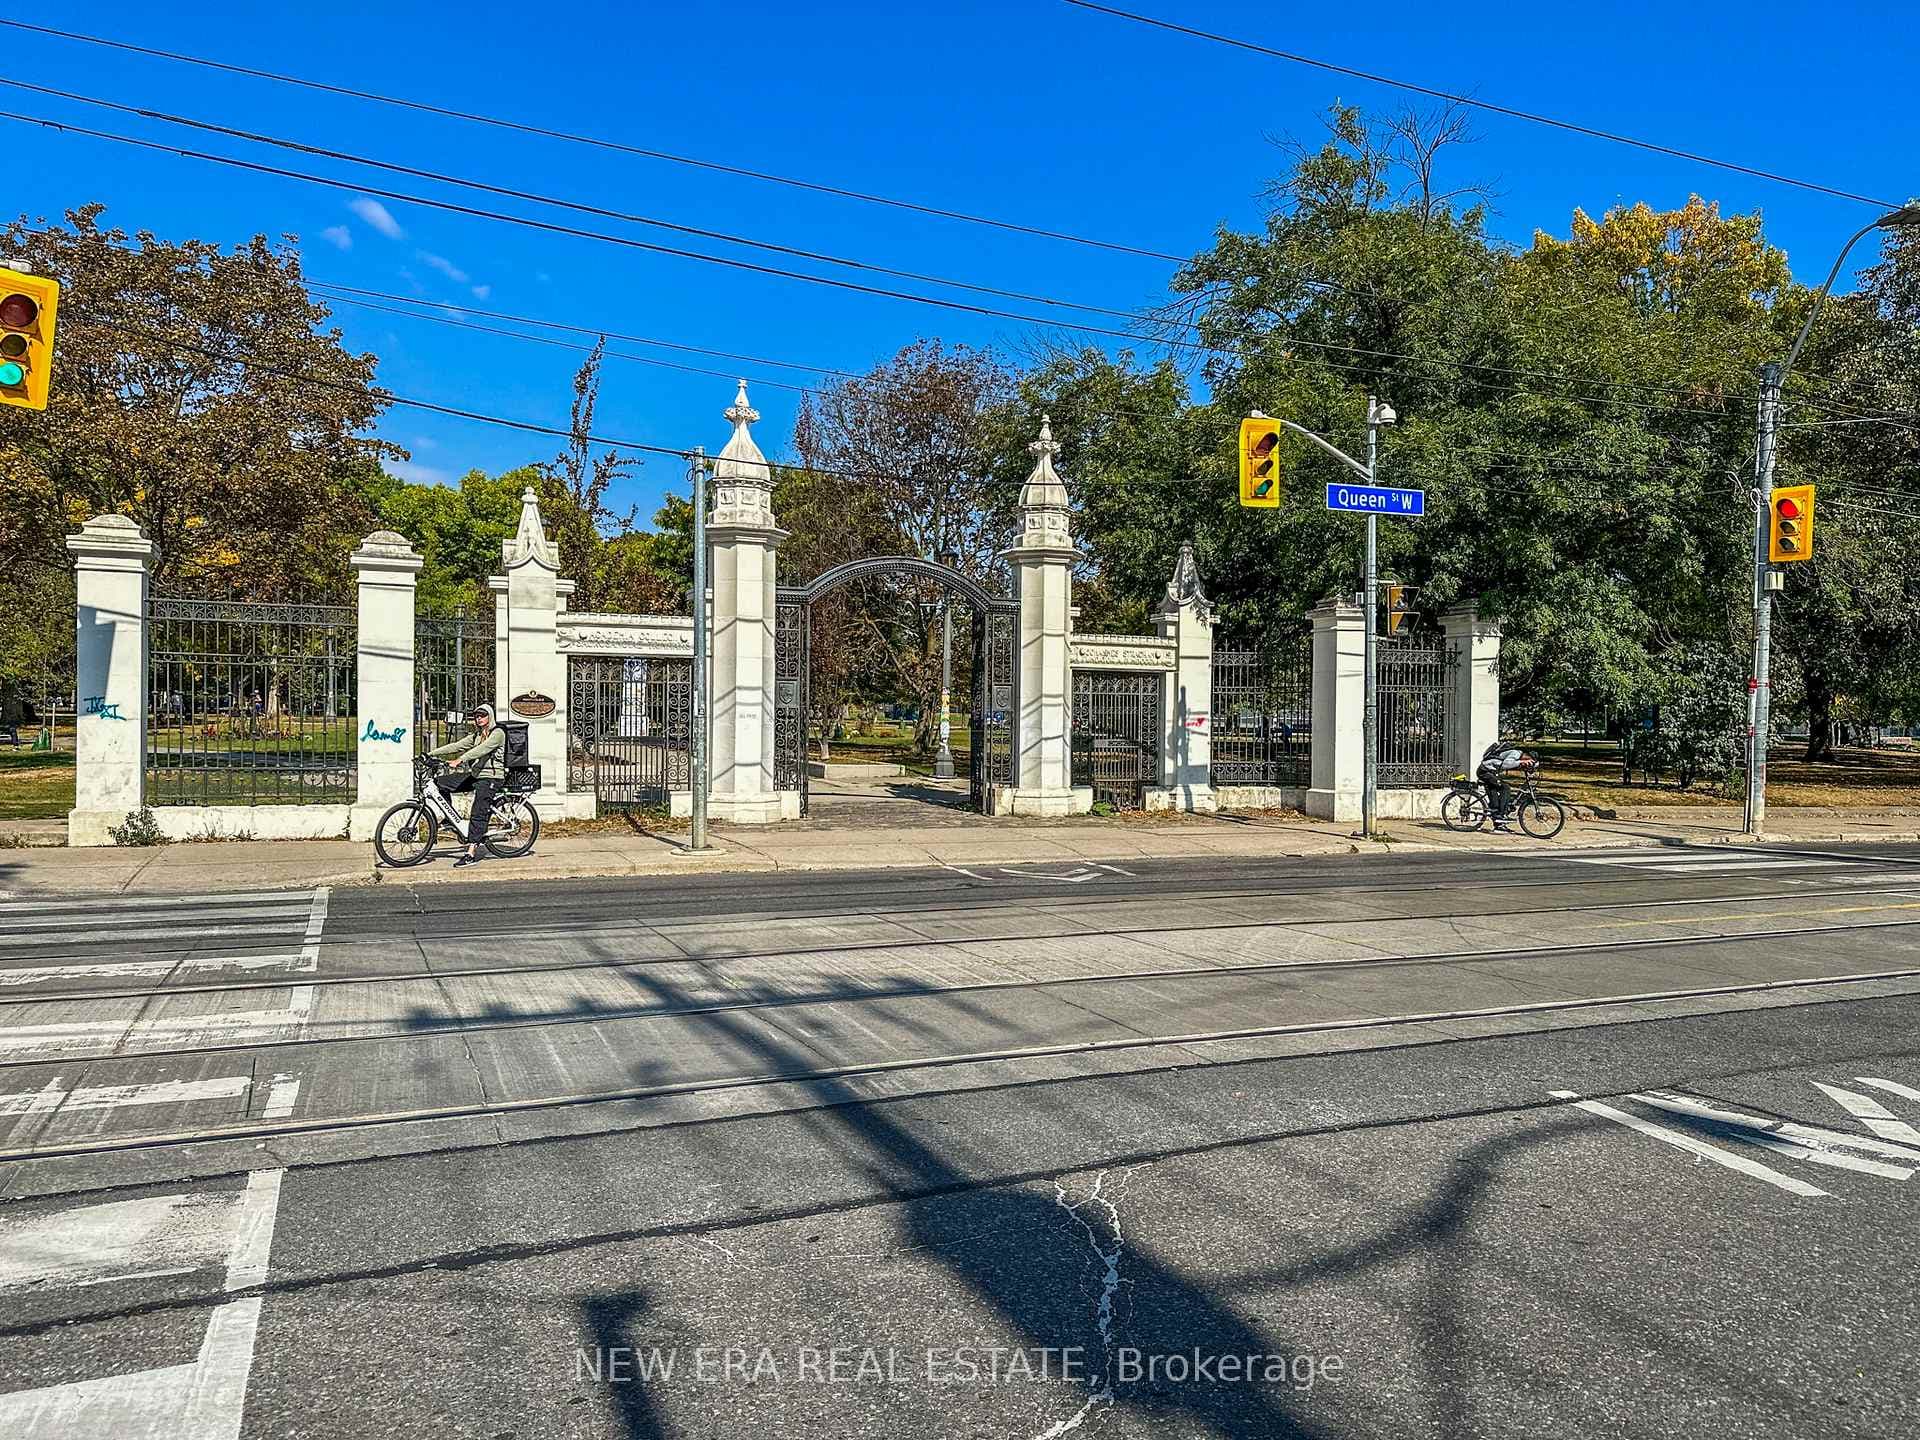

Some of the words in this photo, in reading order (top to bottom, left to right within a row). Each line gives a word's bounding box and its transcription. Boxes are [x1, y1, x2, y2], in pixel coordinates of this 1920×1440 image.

[1338, 489, 1386, 508] Queen
[1391, 492, 1399, 502] St
[1401, 493, 1413, 510] W
